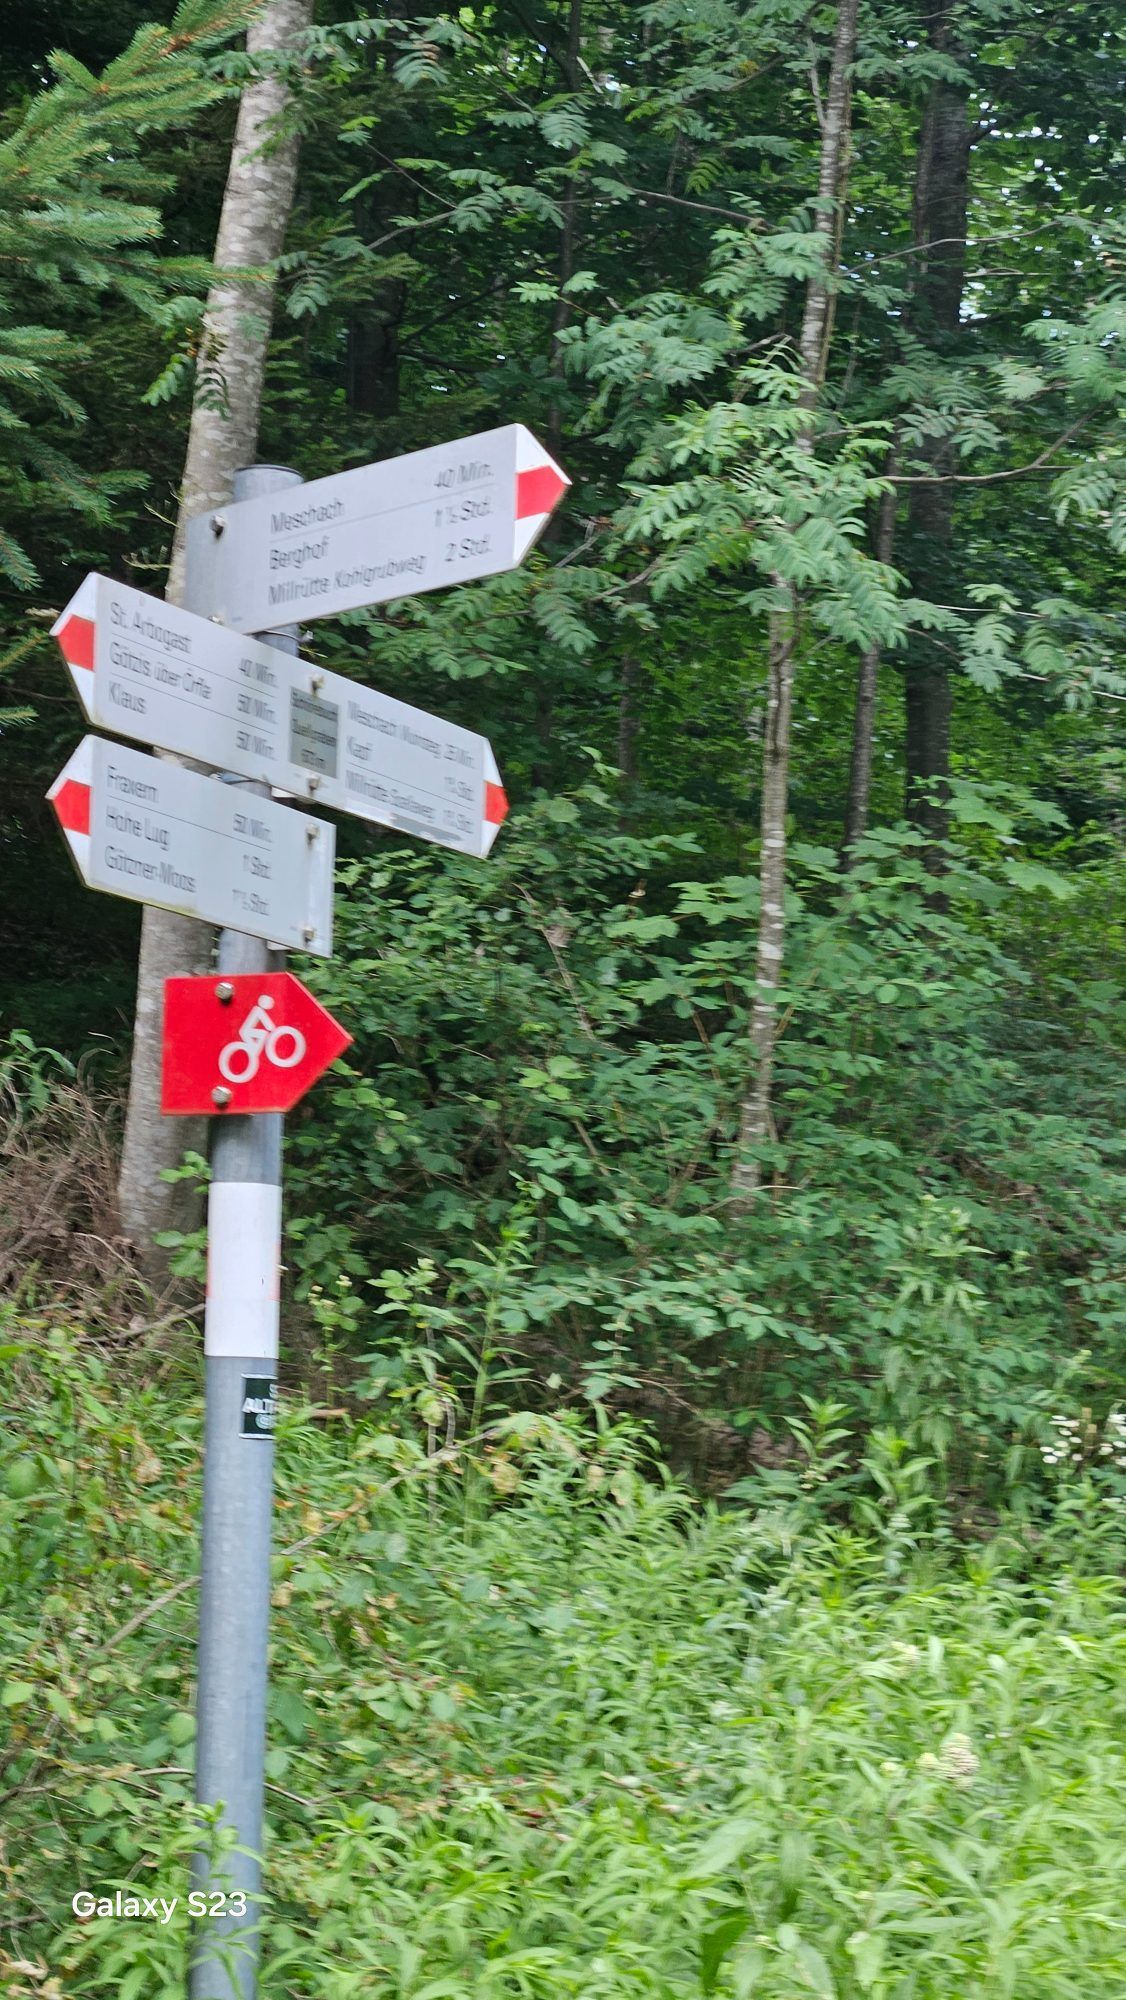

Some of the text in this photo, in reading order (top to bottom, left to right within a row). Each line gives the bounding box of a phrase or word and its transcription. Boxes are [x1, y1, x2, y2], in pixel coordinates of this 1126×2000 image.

[270, 497, 345, 533] Meschach
[269, 535, 331, 570] Berghof
[458, 498, 493, 521] Std.
[444, 542, 458, 562] 2
[459, 535, 493, 559] Std.
[133, 611, 192, 654] Arbogast
[108, 680, 147, 715] Klaus
[105, 804, 143, 838] Hohe
